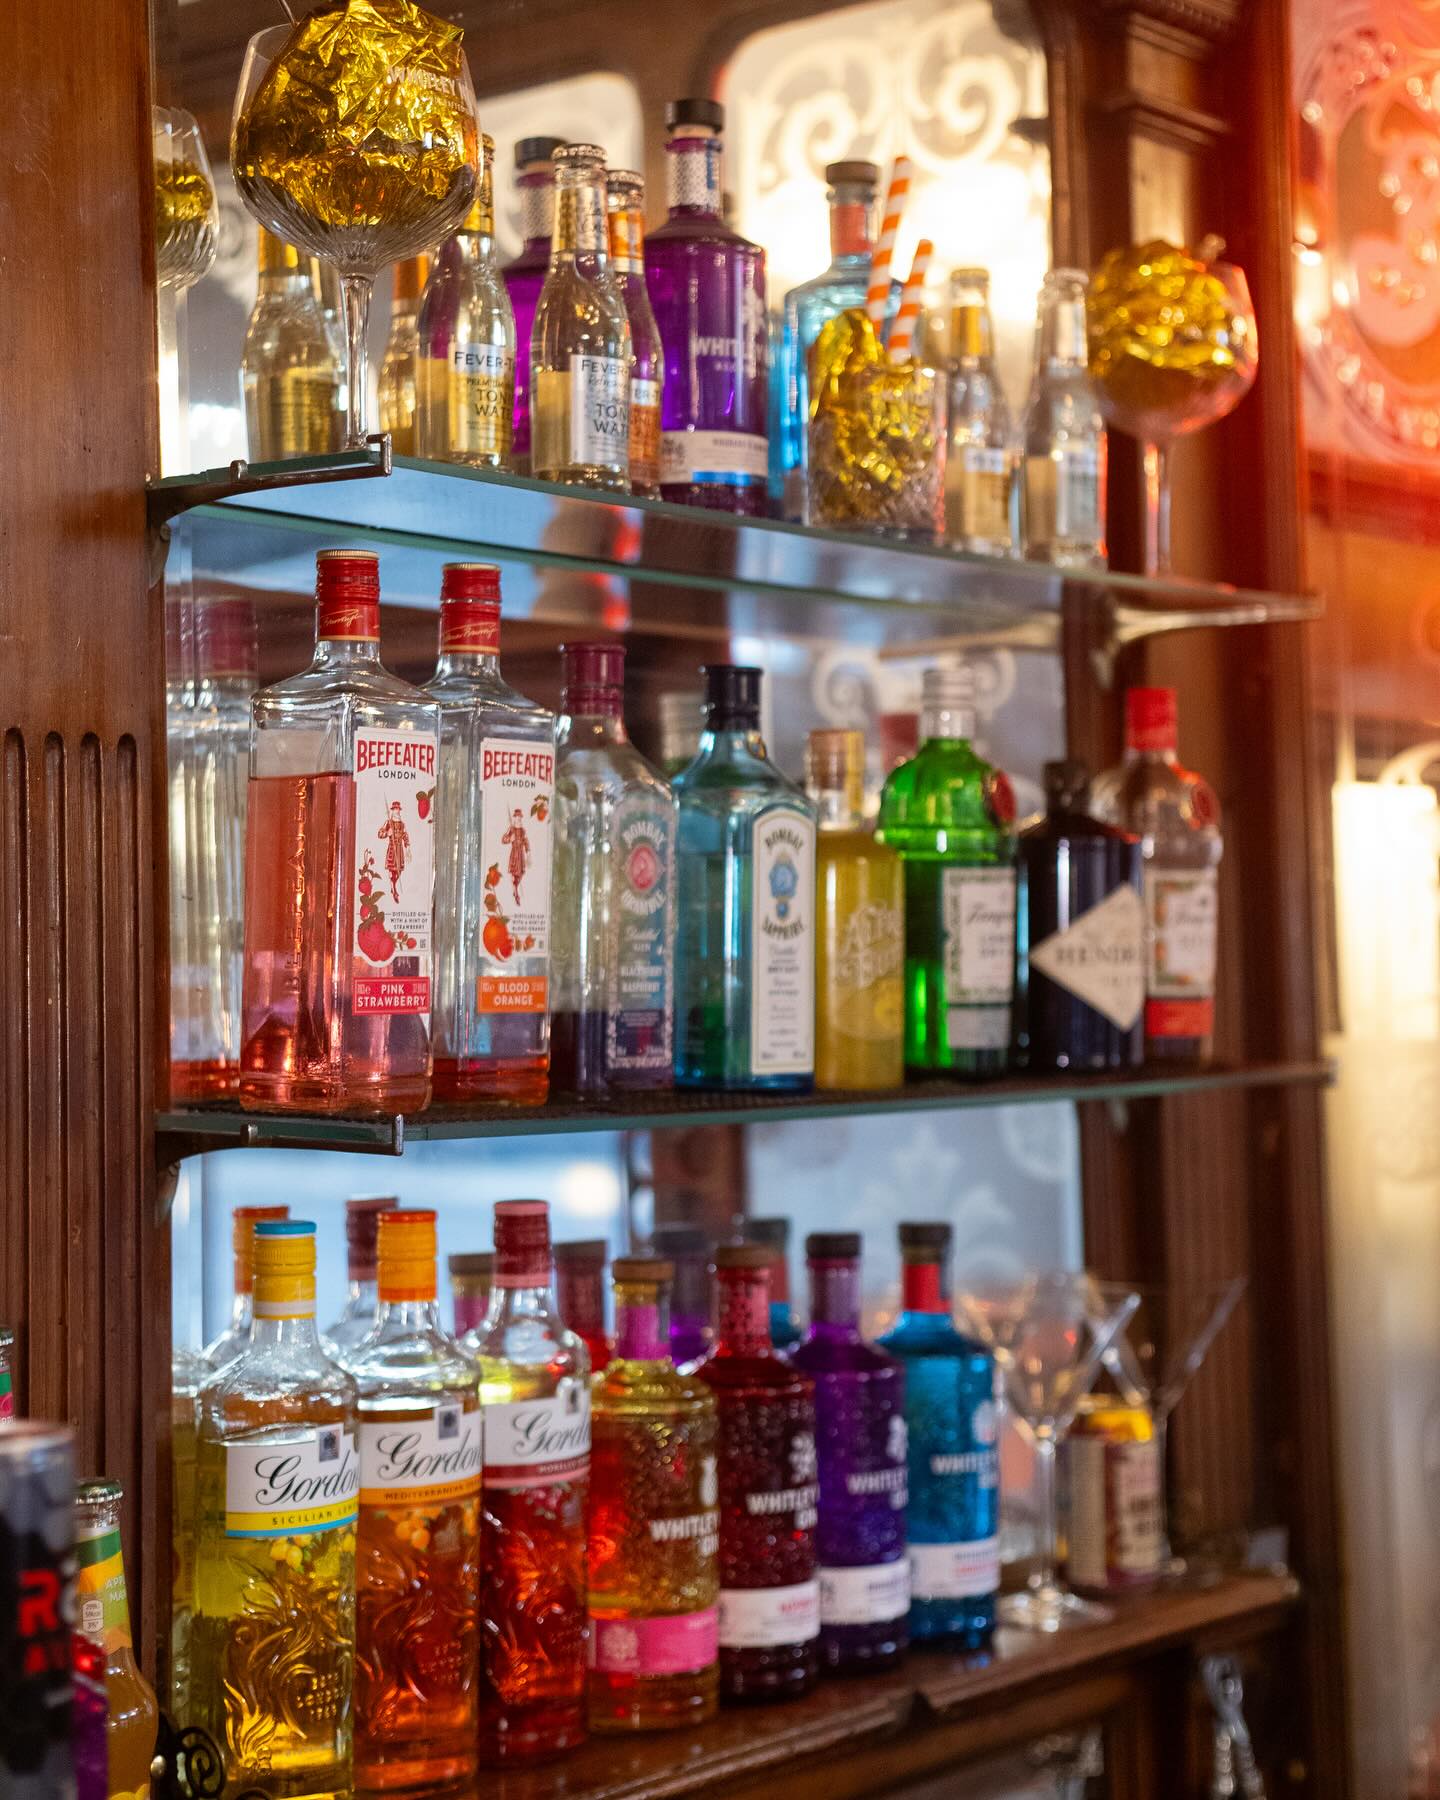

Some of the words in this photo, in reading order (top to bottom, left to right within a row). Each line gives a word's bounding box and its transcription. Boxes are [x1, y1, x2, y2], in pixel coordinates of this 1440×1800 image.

[357, 740, 435, 777] BEEFEATER
[484, 750, 553, 785] BEEFEATER
[378, 770, 416, 780] LONDON
[502, 779, 536, 788] LONDON
[381, 984, 405, 995] PINK
[498, 983, 531, 993] BLOOD
[357, 996, 427, 1008] STRAWBERRY
[493, 995, 534, 1006] ORANGE
[272, 1511, 332, 1526] SICILIAN
